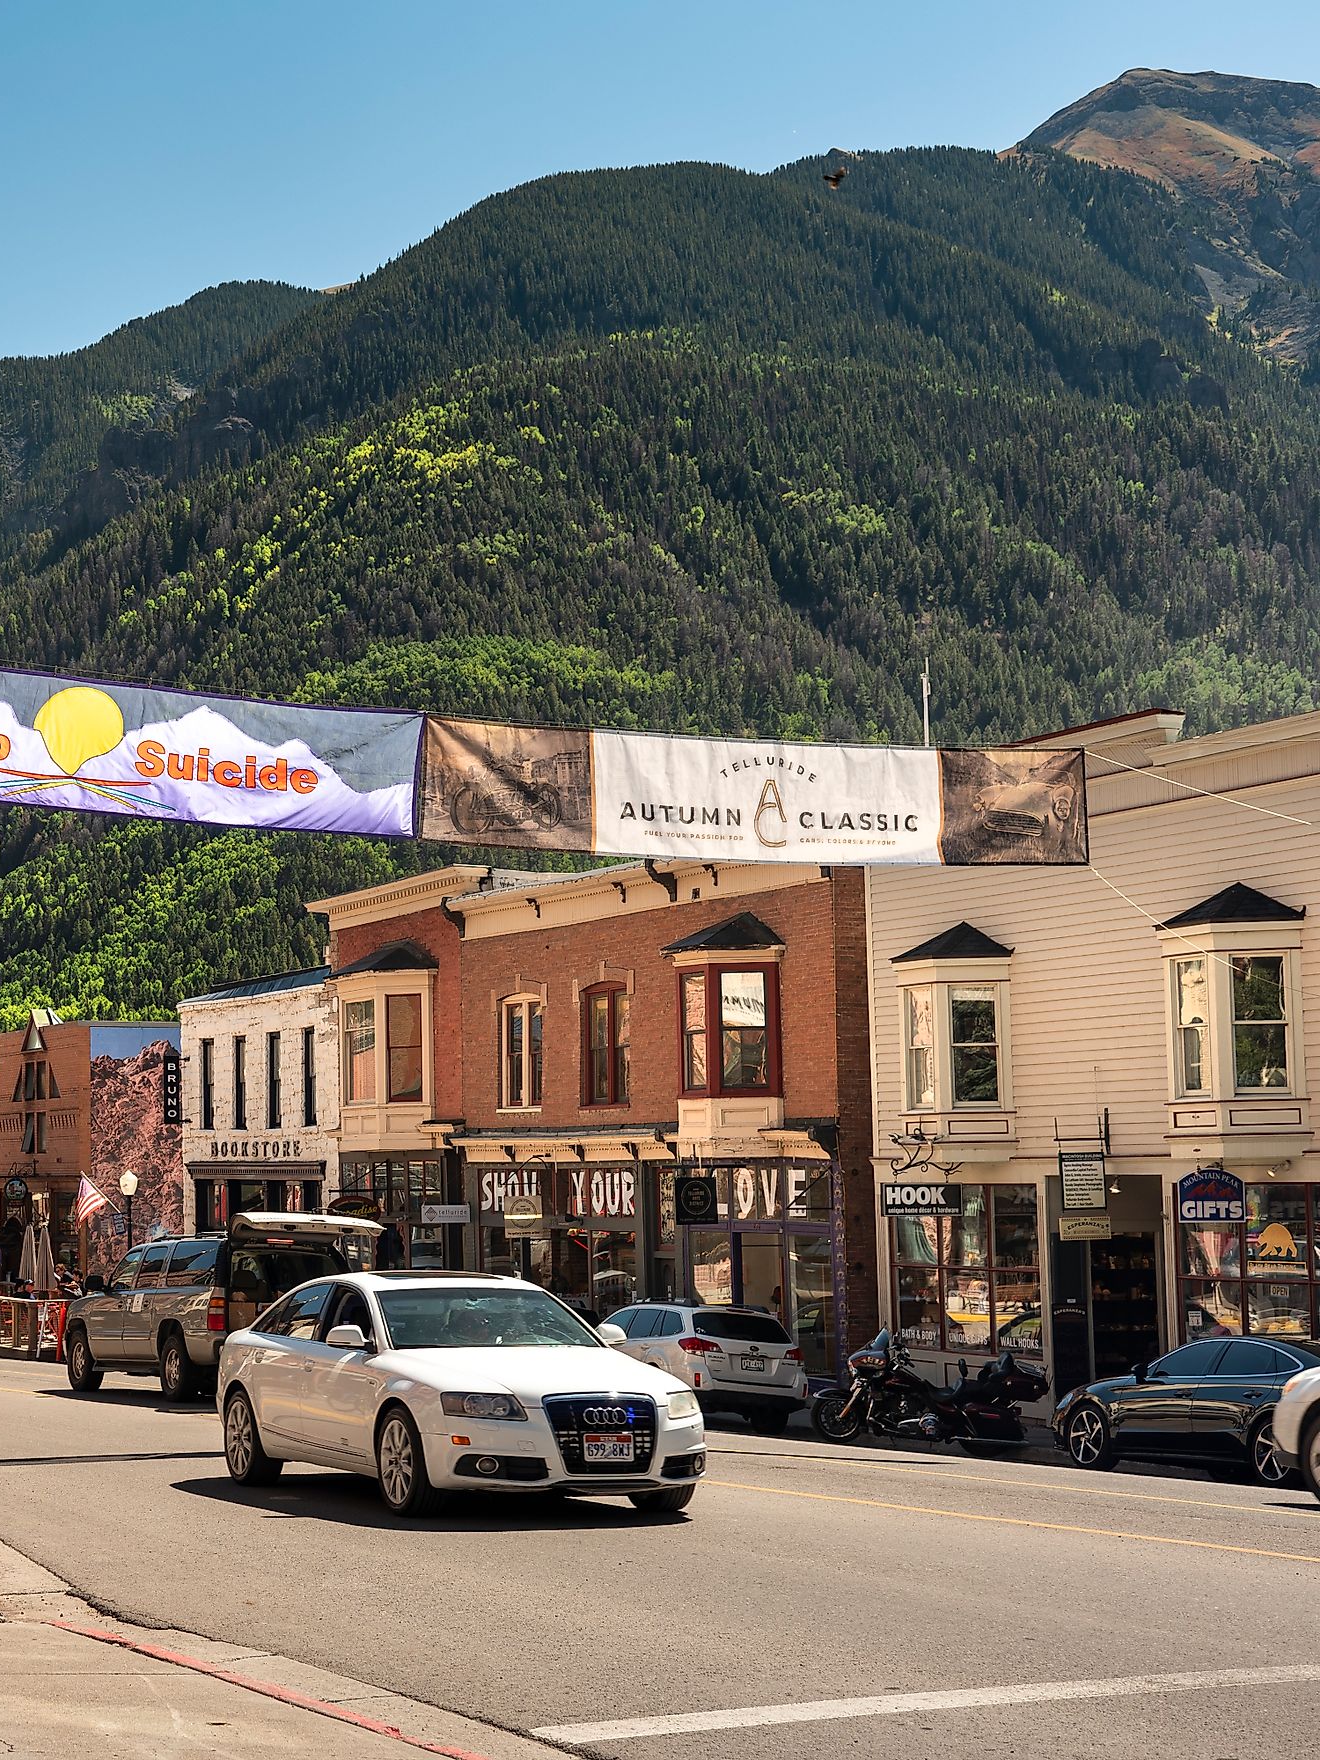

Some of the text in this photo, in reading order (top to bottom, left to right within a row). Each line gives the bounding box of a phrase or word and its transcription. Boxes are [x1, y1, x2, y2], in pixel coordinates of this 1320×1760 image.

[135, 740, 318, 794] Suicide
[720, 756, 817, 783] TELLURIDE
[620, 801, 919, 832] AUTUMN CLASSIC
[167, 1062, 178, 1118] BRUNO
[210, 1140, 302, 1158] BOOKSTORE
[1182, 1172, 1240, 1189] MOUNTAIN PEAK
[571, 1171, 635, 1216] YOUR
[886, 1186, 946, 1205] HOOK
[1181, 1200, 1242, 1218] GIFTS
[1067, 1222, 1104, 1231] ESPERANZA'S
[1272, 1286, 1288, 1296] OPEN
[901, 1328, 937, 1341] BATH & BODY
[948, 1333, 988, 1346] UNIQUE GIFTS
[1000, 1336, 1039, 1349] WALL HOOKS
[587, 1443, 606, 1457] G99
